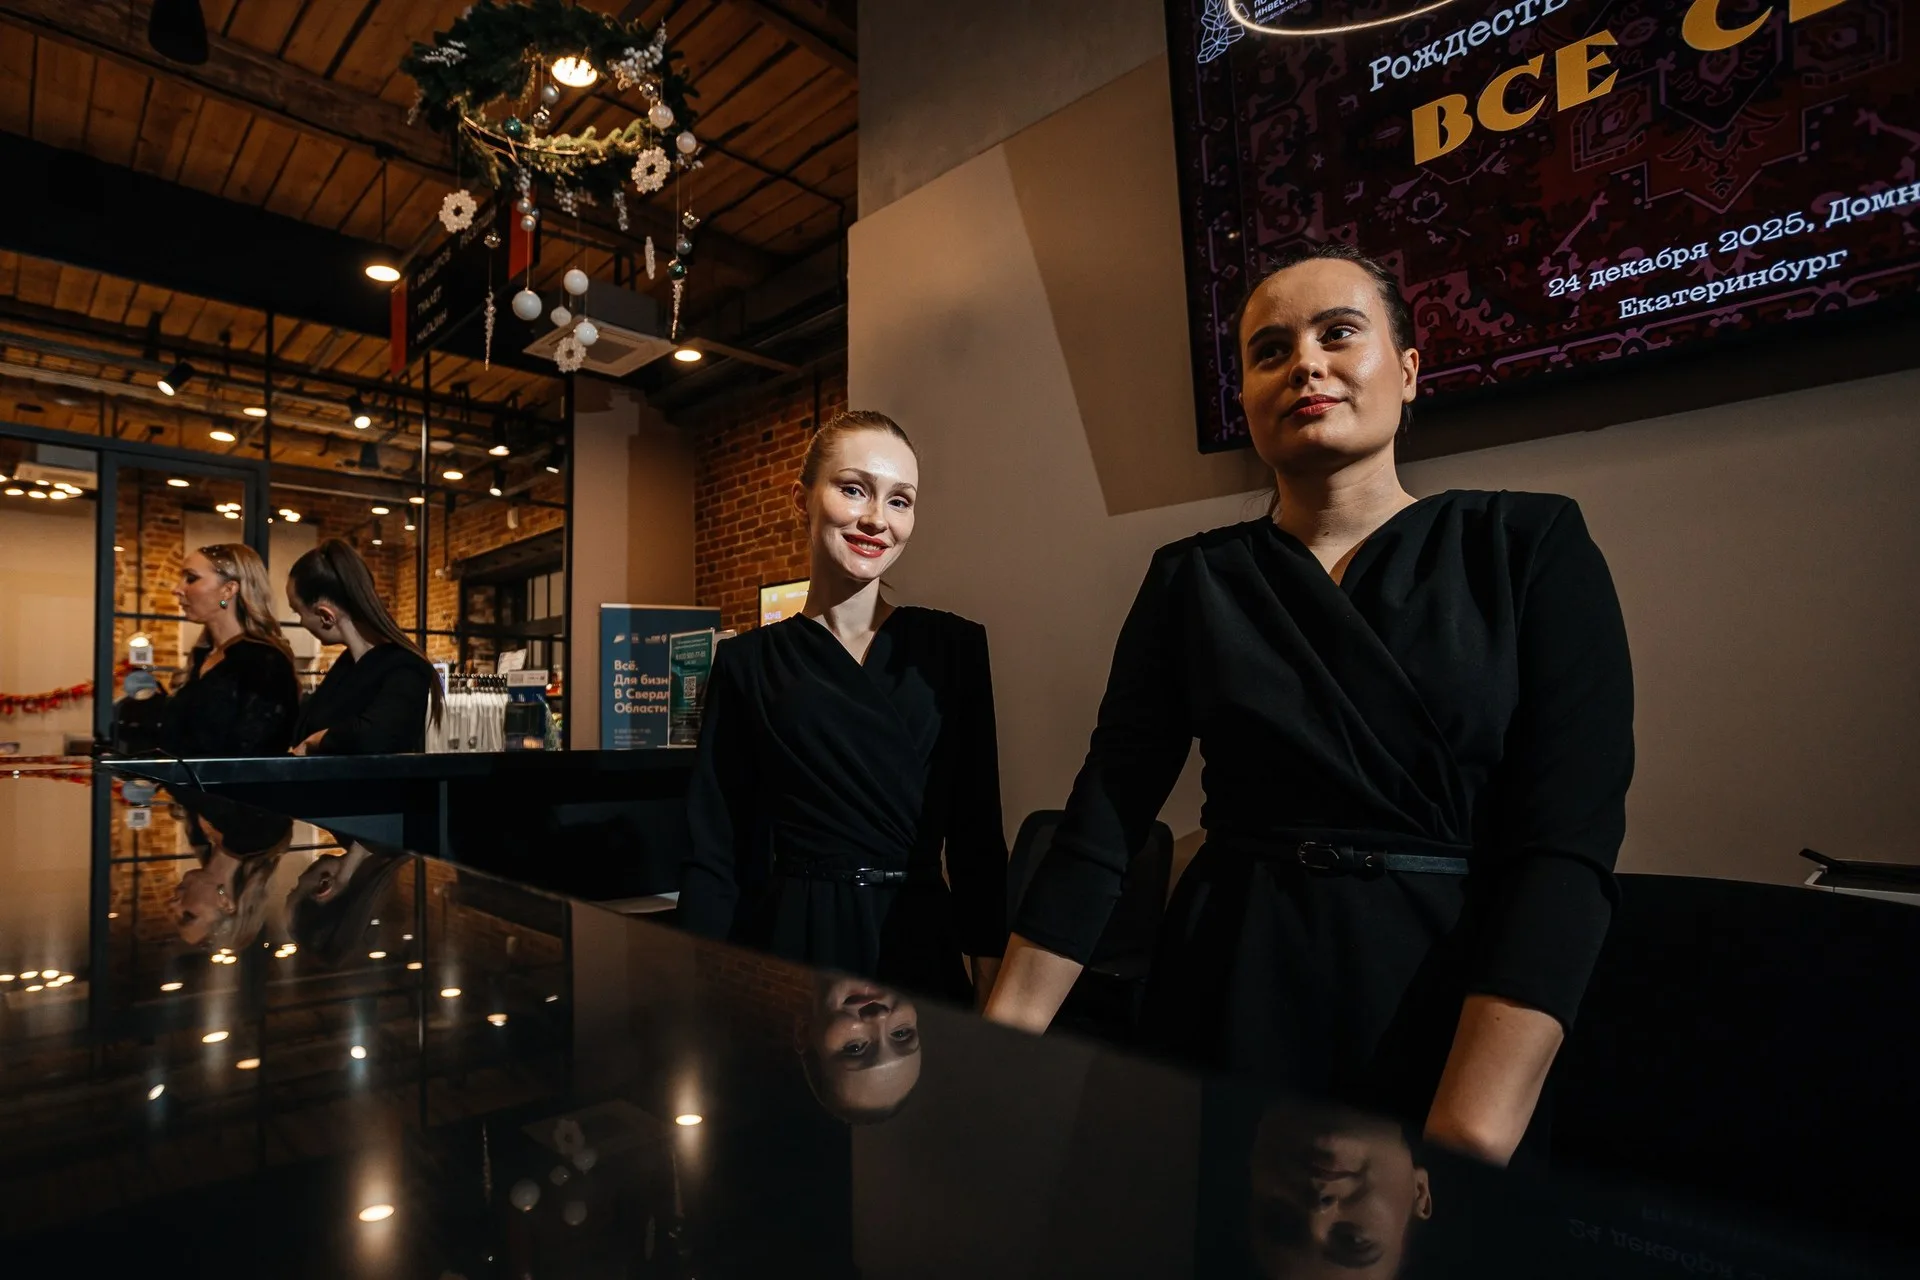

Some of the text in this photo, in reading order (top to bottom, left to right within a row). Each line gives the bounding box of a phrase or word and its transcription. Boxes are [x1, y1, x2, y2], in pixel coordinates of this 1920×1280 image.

[1255, 0, 1291, 18] ИНВЕС
[1682, 0, 1846, 51] С
[1411, 29, 1619, 165] ВСЕ
[1548, 278, 1581, 297] 24
[1589, 242, 1709, 290] декабря
[1718, 212, 1815, 253] 2025,
[1618, 250, 1848, 319] Екатеринбург
[613, 673, 671, 686] Для бизн
[614, 660, 638, 671] Всё.
[614, 688, 623, 699] В
